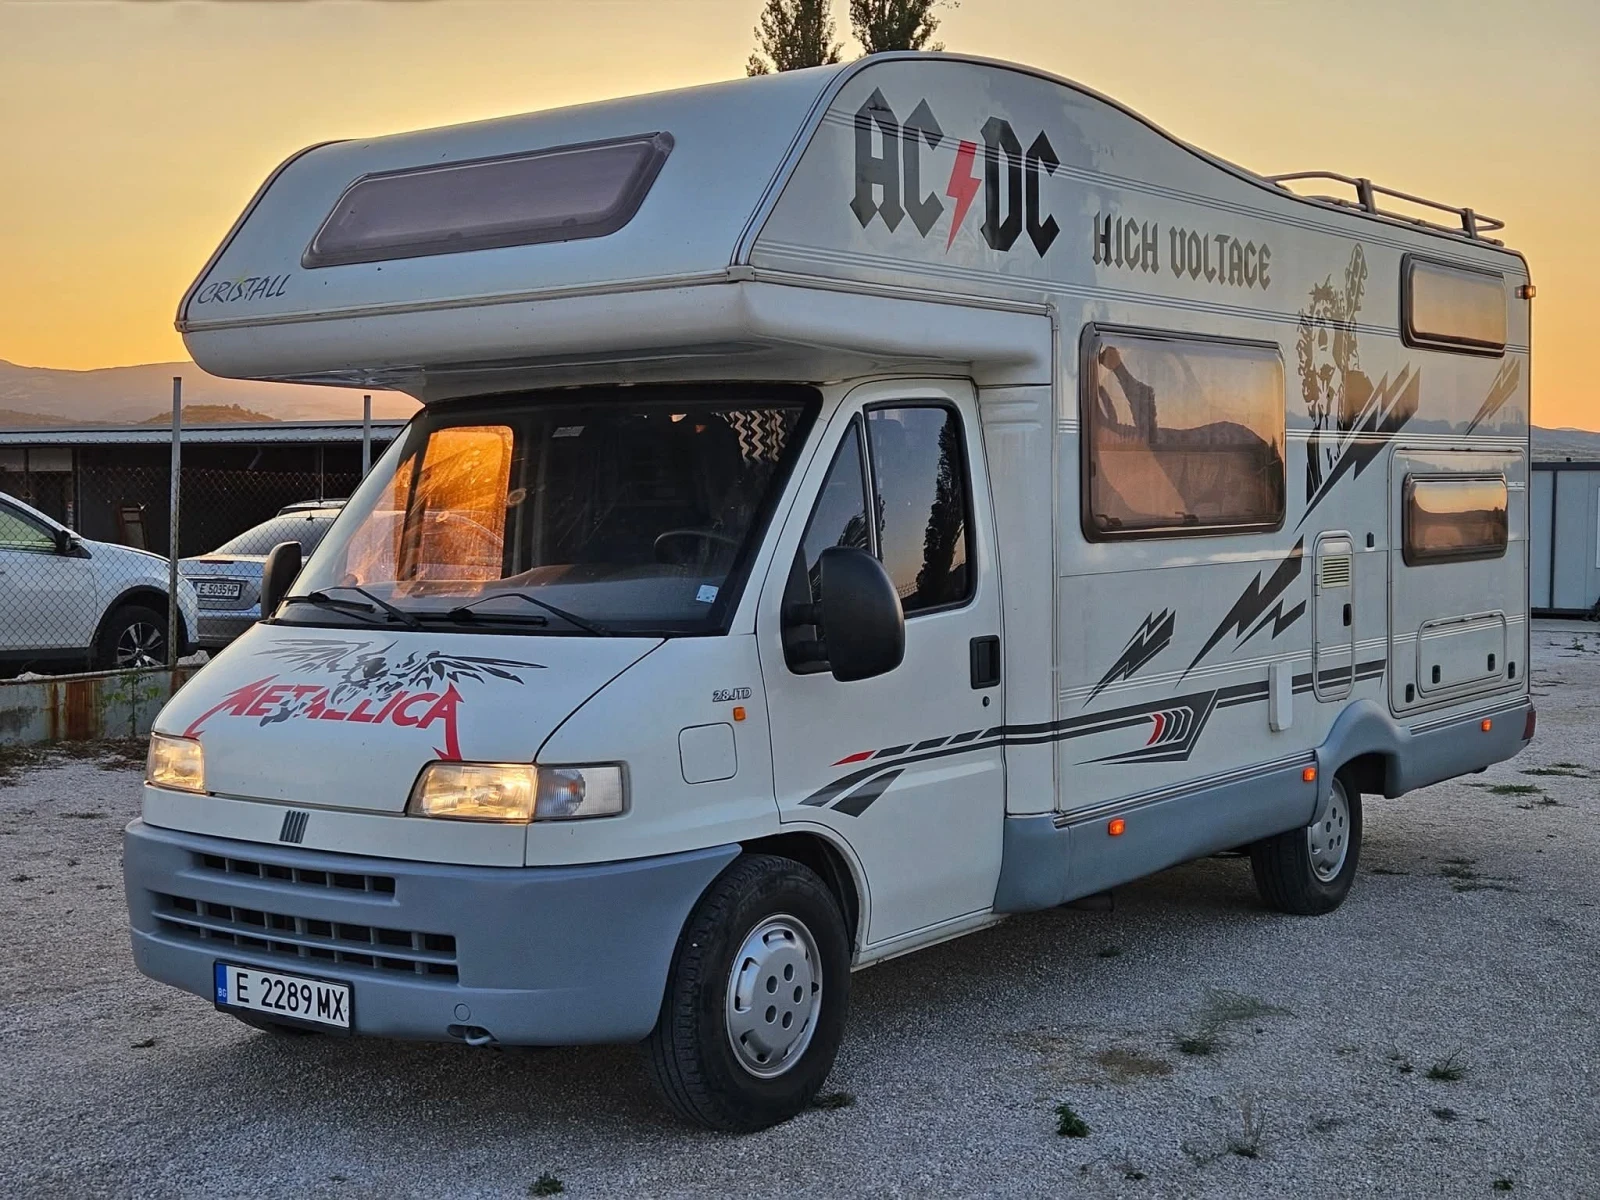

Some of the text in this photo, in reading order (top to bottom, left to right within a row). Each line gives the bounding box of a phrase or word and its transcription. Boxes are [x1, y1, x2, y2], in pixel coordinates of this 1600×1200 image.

[1093, 211, 1271, 290] HIGH VOLTAGE
[198, 274, 292, 303] CRISTALL
[184, 675, 464, 761] METALLICA
[218, 987, 227, 998] BG
[236, 972, 250, 1003] E
